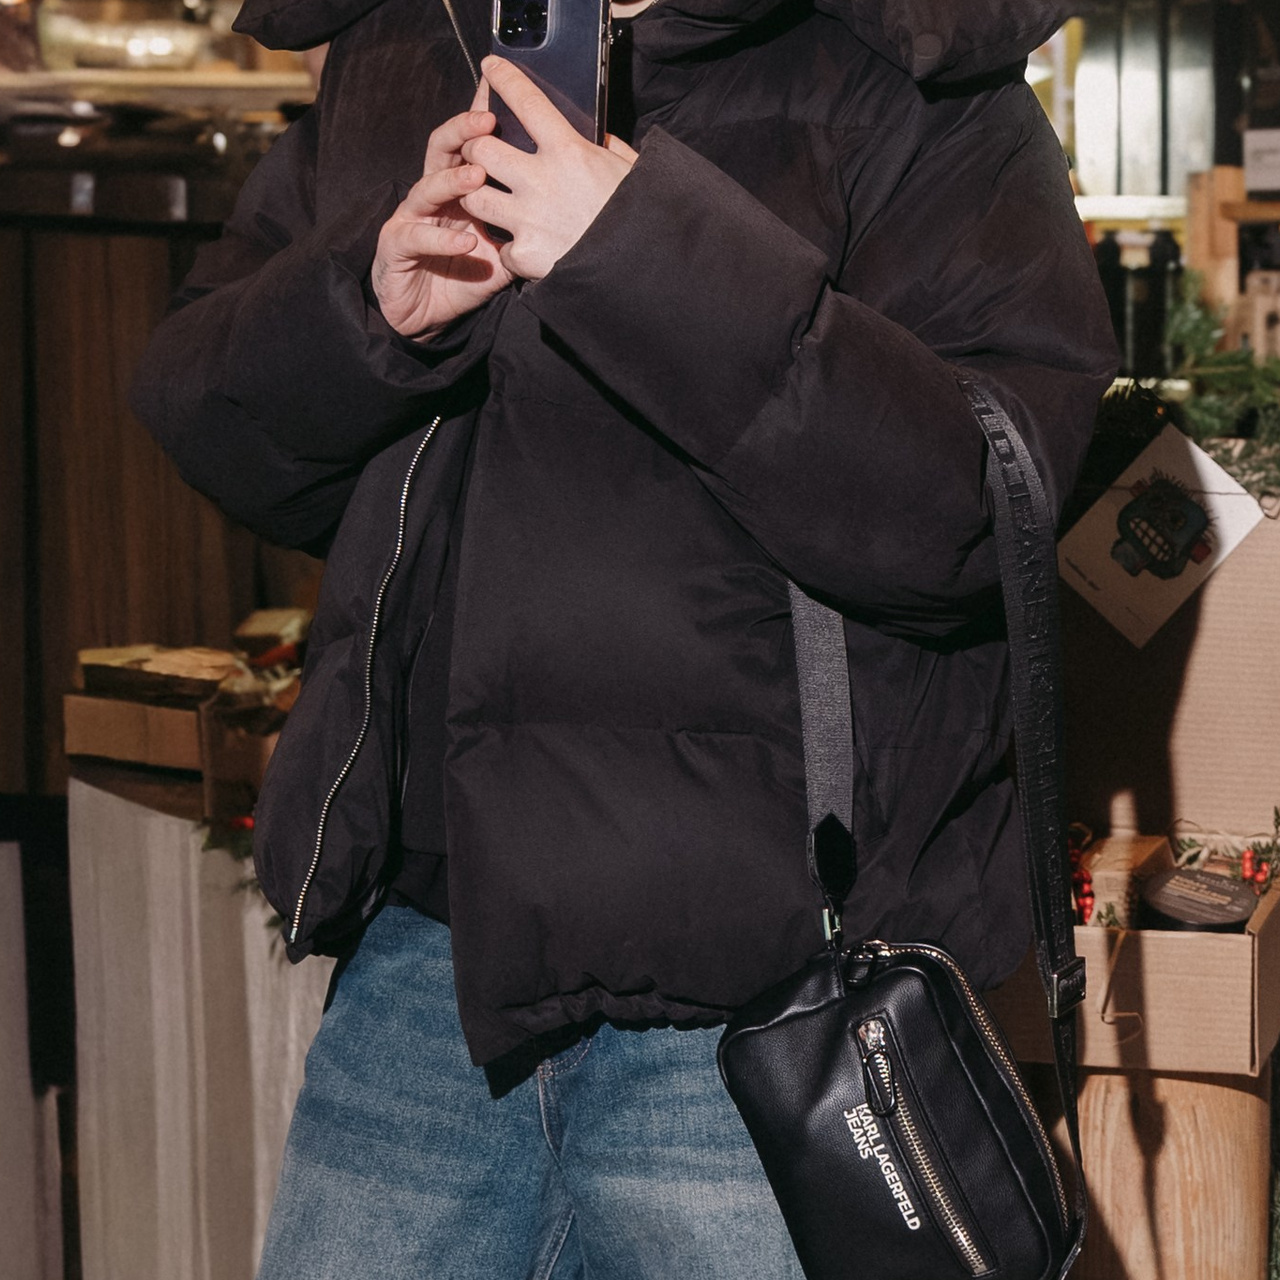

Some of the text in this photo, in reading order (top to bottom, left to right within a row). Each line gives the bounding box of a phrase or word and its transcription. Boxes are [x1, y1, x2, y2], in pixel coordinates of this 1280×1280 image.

[843, 1107, 874, 1160] JEANS
[856, 1102, 921, 1231] KARL LAGERFELD
